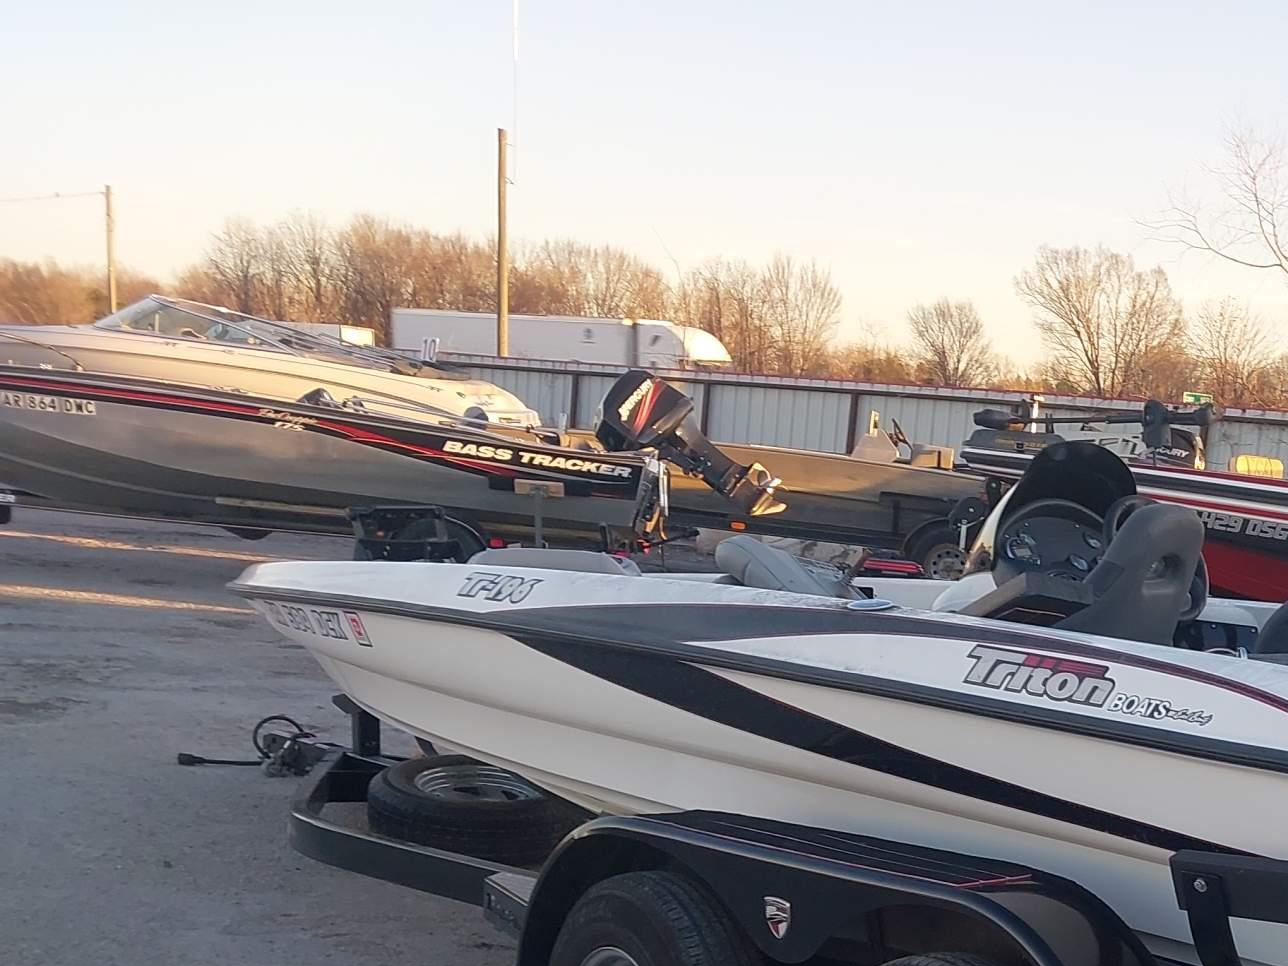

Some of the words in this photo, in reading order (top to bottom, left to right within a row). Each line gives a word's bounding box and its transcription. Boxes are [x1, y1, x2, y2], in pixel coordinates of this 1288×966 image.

[617, 378, 653, 421] MERCURY
[443, 440, 512, 461] BASS
[519, 451, 632, 478] TRACKER
[963, 643, 1116, 708] Triton
[1108, 692, 1172, 720] BOATS
